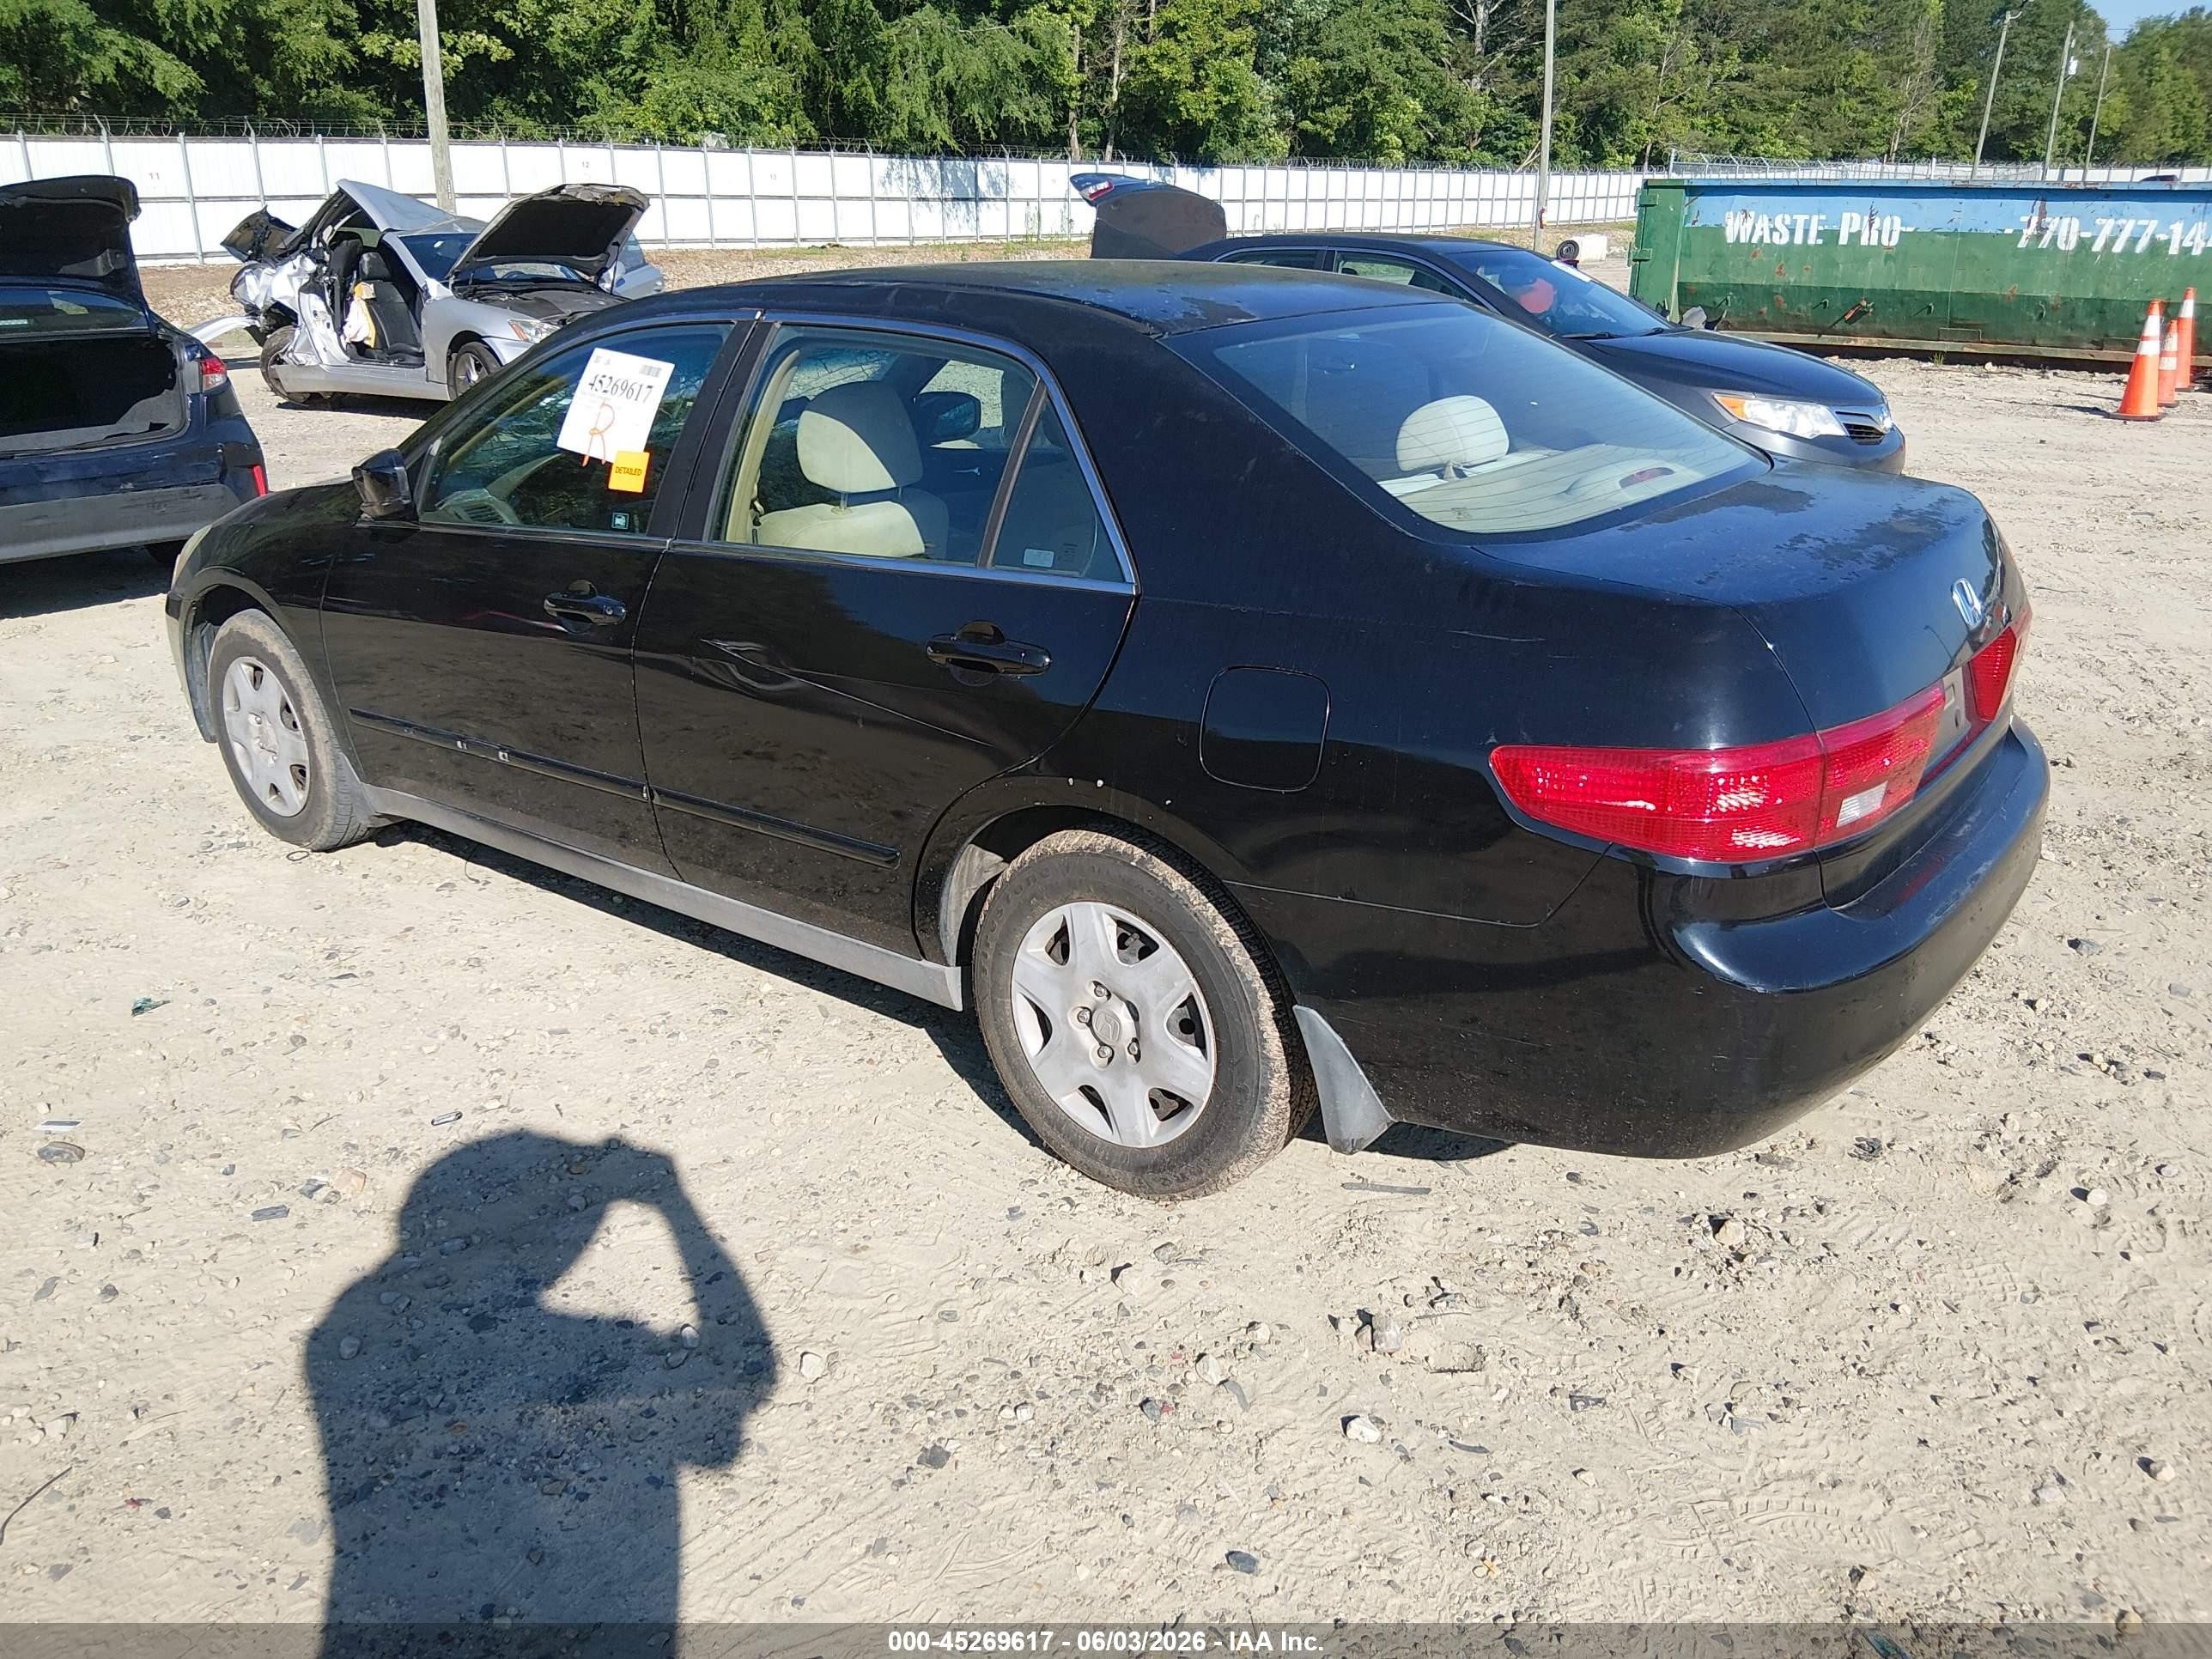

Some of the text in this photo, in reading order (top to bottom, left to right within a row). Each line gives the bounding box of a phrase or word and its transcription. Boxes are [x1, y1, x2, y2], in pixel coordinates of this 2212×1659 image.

[1724, 210, 1901, 247] WASTE PRO
[2017, 216, 2212, 256] 770-777-14
[588, 374, 654, 403] 45269617
[615, 465, 642, 477] DETAILED
